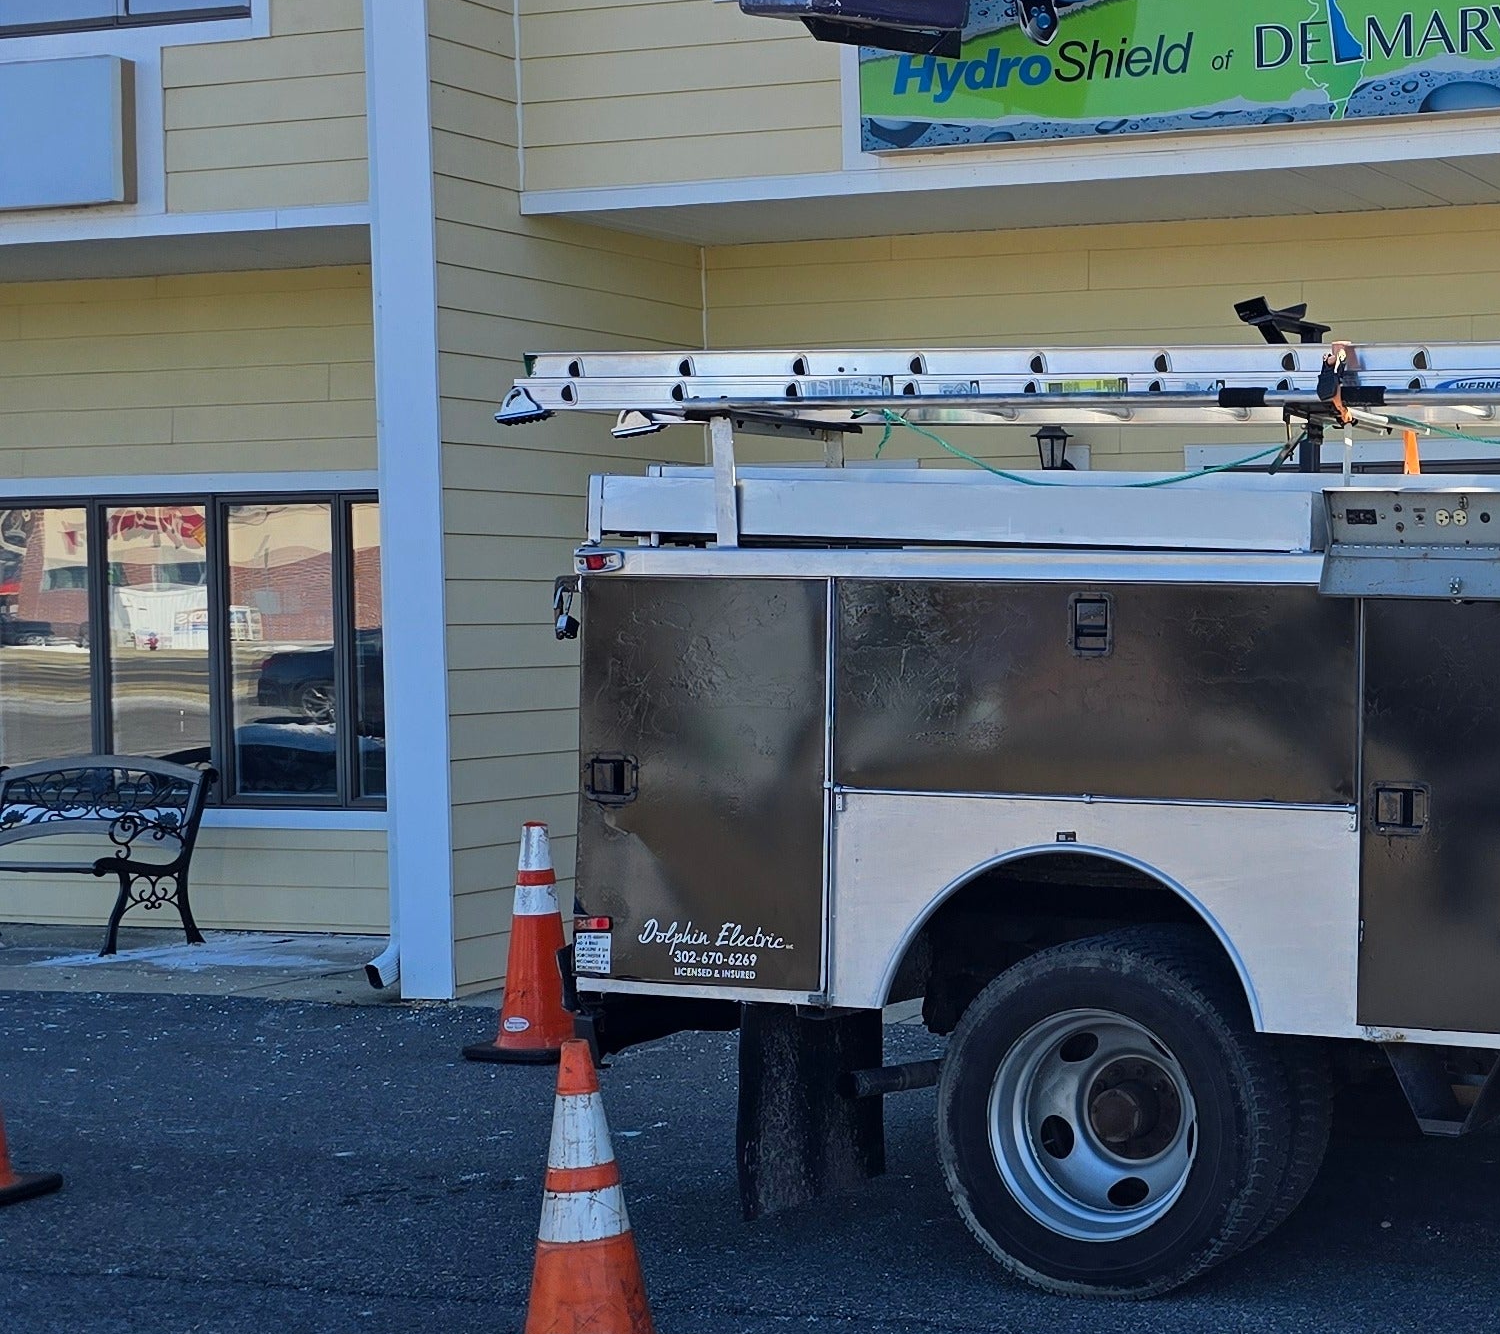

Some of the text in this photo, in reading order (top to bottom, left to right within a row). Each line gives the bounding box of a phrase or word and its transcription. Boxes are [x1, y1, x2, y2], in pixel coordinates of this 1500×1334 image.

[1211, 50, 1234, 72] of
[638, 918, 711, 956] Dolphin
[715, 922, 786, 949] Electric
[673, 950, 758, 967] 302-670-6269
[674, 967, 756, 980] LICENSED & INSURED
